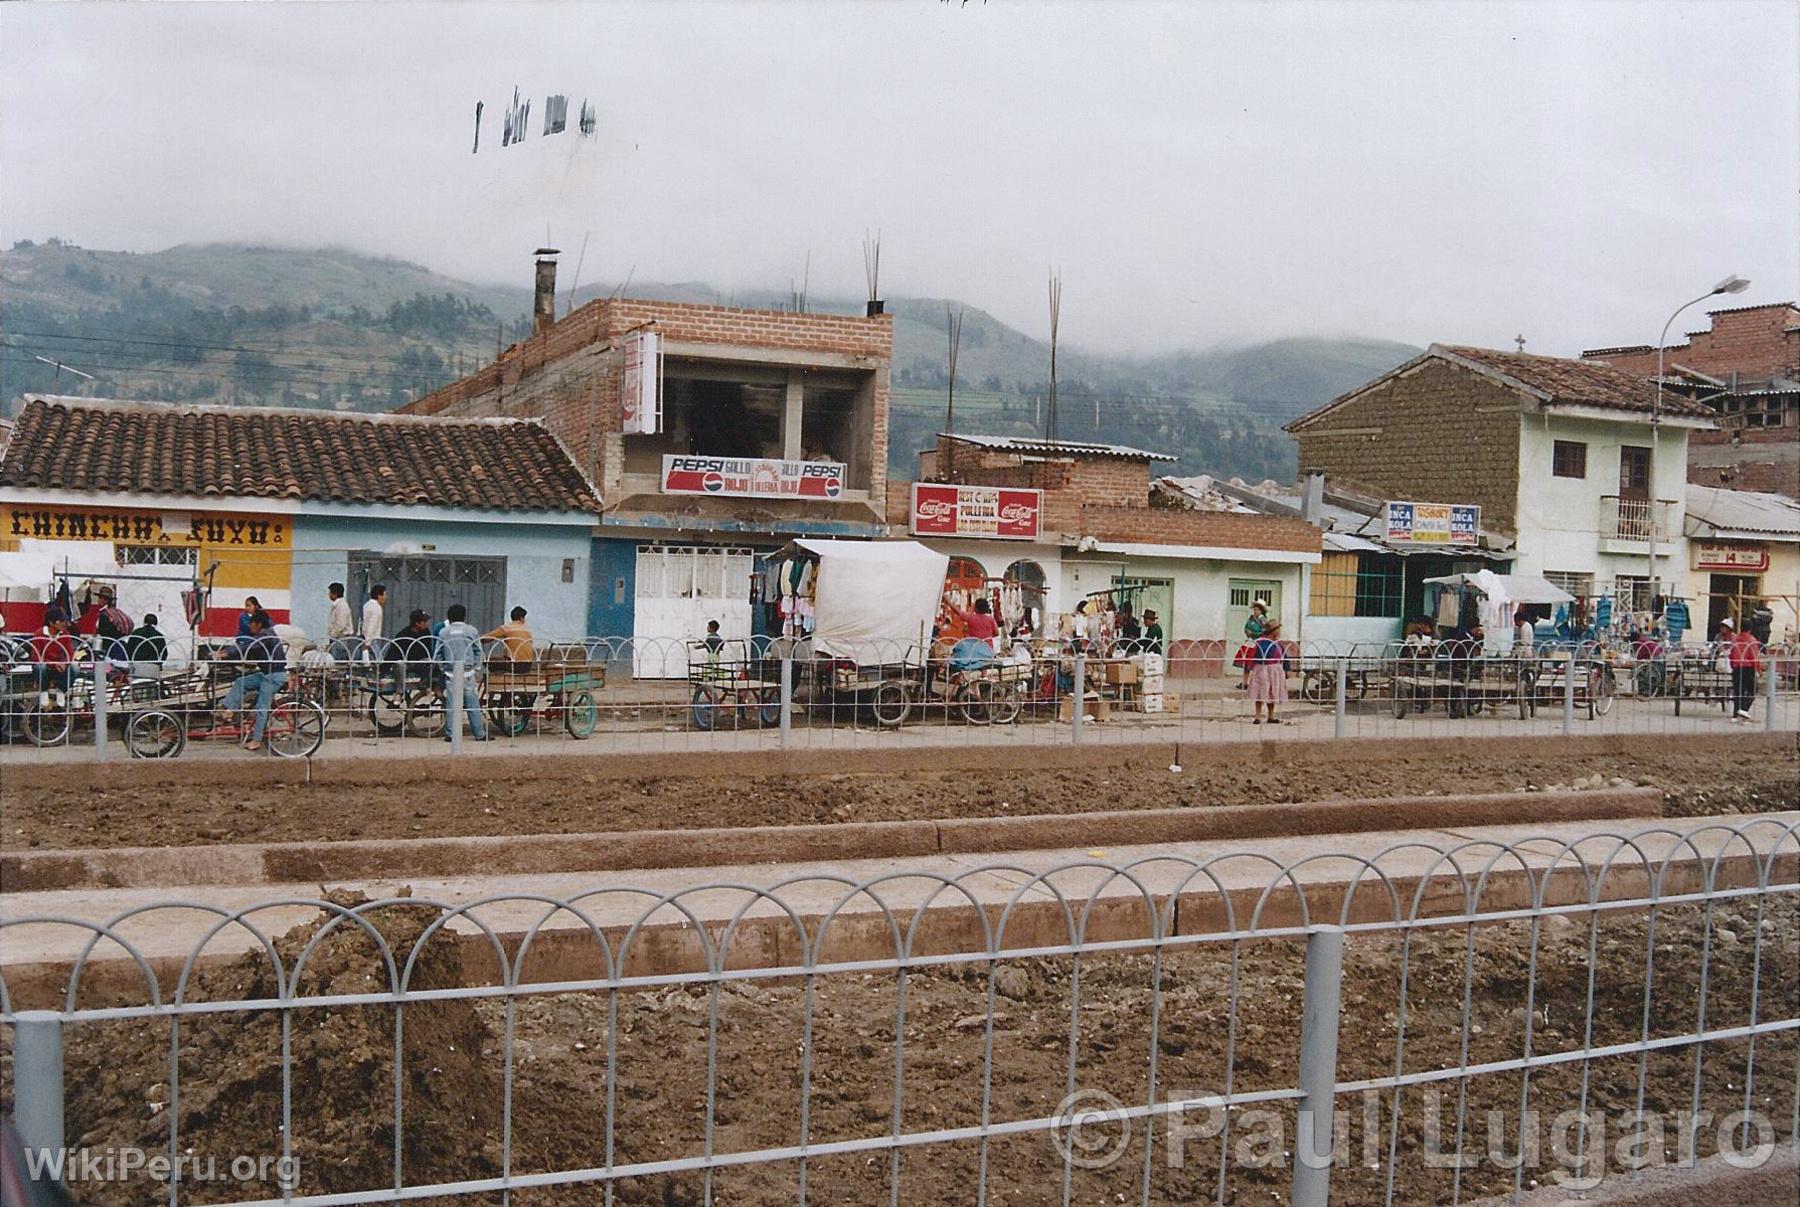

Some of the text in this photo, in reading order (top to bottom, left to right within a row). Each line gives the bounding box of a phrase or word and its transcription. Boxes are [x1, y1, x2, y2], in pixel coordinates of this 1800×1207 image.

[671, 458, 750, 475] PEPSI GALLO
[802, 465, 841, 478] PEPSI
[724, 477, 749, 492] ROJO
[1388, 510, 1411, 520] INCA
[1453, 513, 1473, 522] INCA
